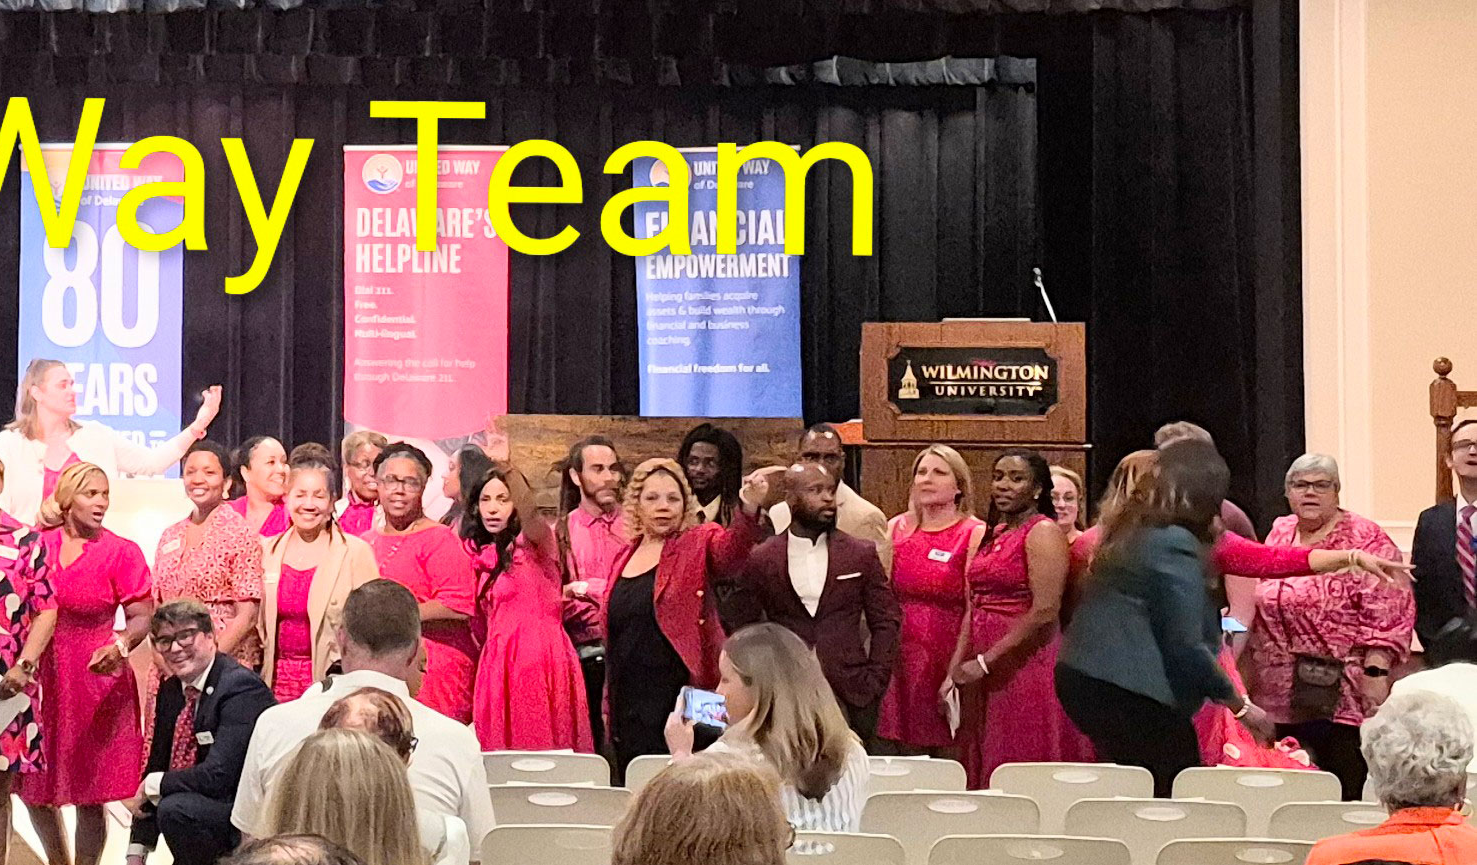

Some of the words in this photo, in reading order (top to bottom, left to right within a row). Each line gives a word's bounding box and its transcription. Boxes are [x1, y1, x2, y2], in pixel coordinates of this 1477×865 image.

[453, 160, 481, 175] WAY
[742, 160, 770, 176] WAY
[693, 179, 705, 190] of
[80, 195, 91, 206] of
[355, 243, 462, 274] HELPLINE
[645, 252, 792, 280] EMPOWERMENT
[41, 219, 160, 348] 80
[713, 305, 746, 316] wealth
[747, 304, 785, 317] through
[688, 320, 707, 330] and
[738, 362, 754, 374] for
[921, 364, 1049, 381] WILMINGTON
[67, 362, 159, 417] EARS
[934, 385, 1039, 398] UNIVERSITY
